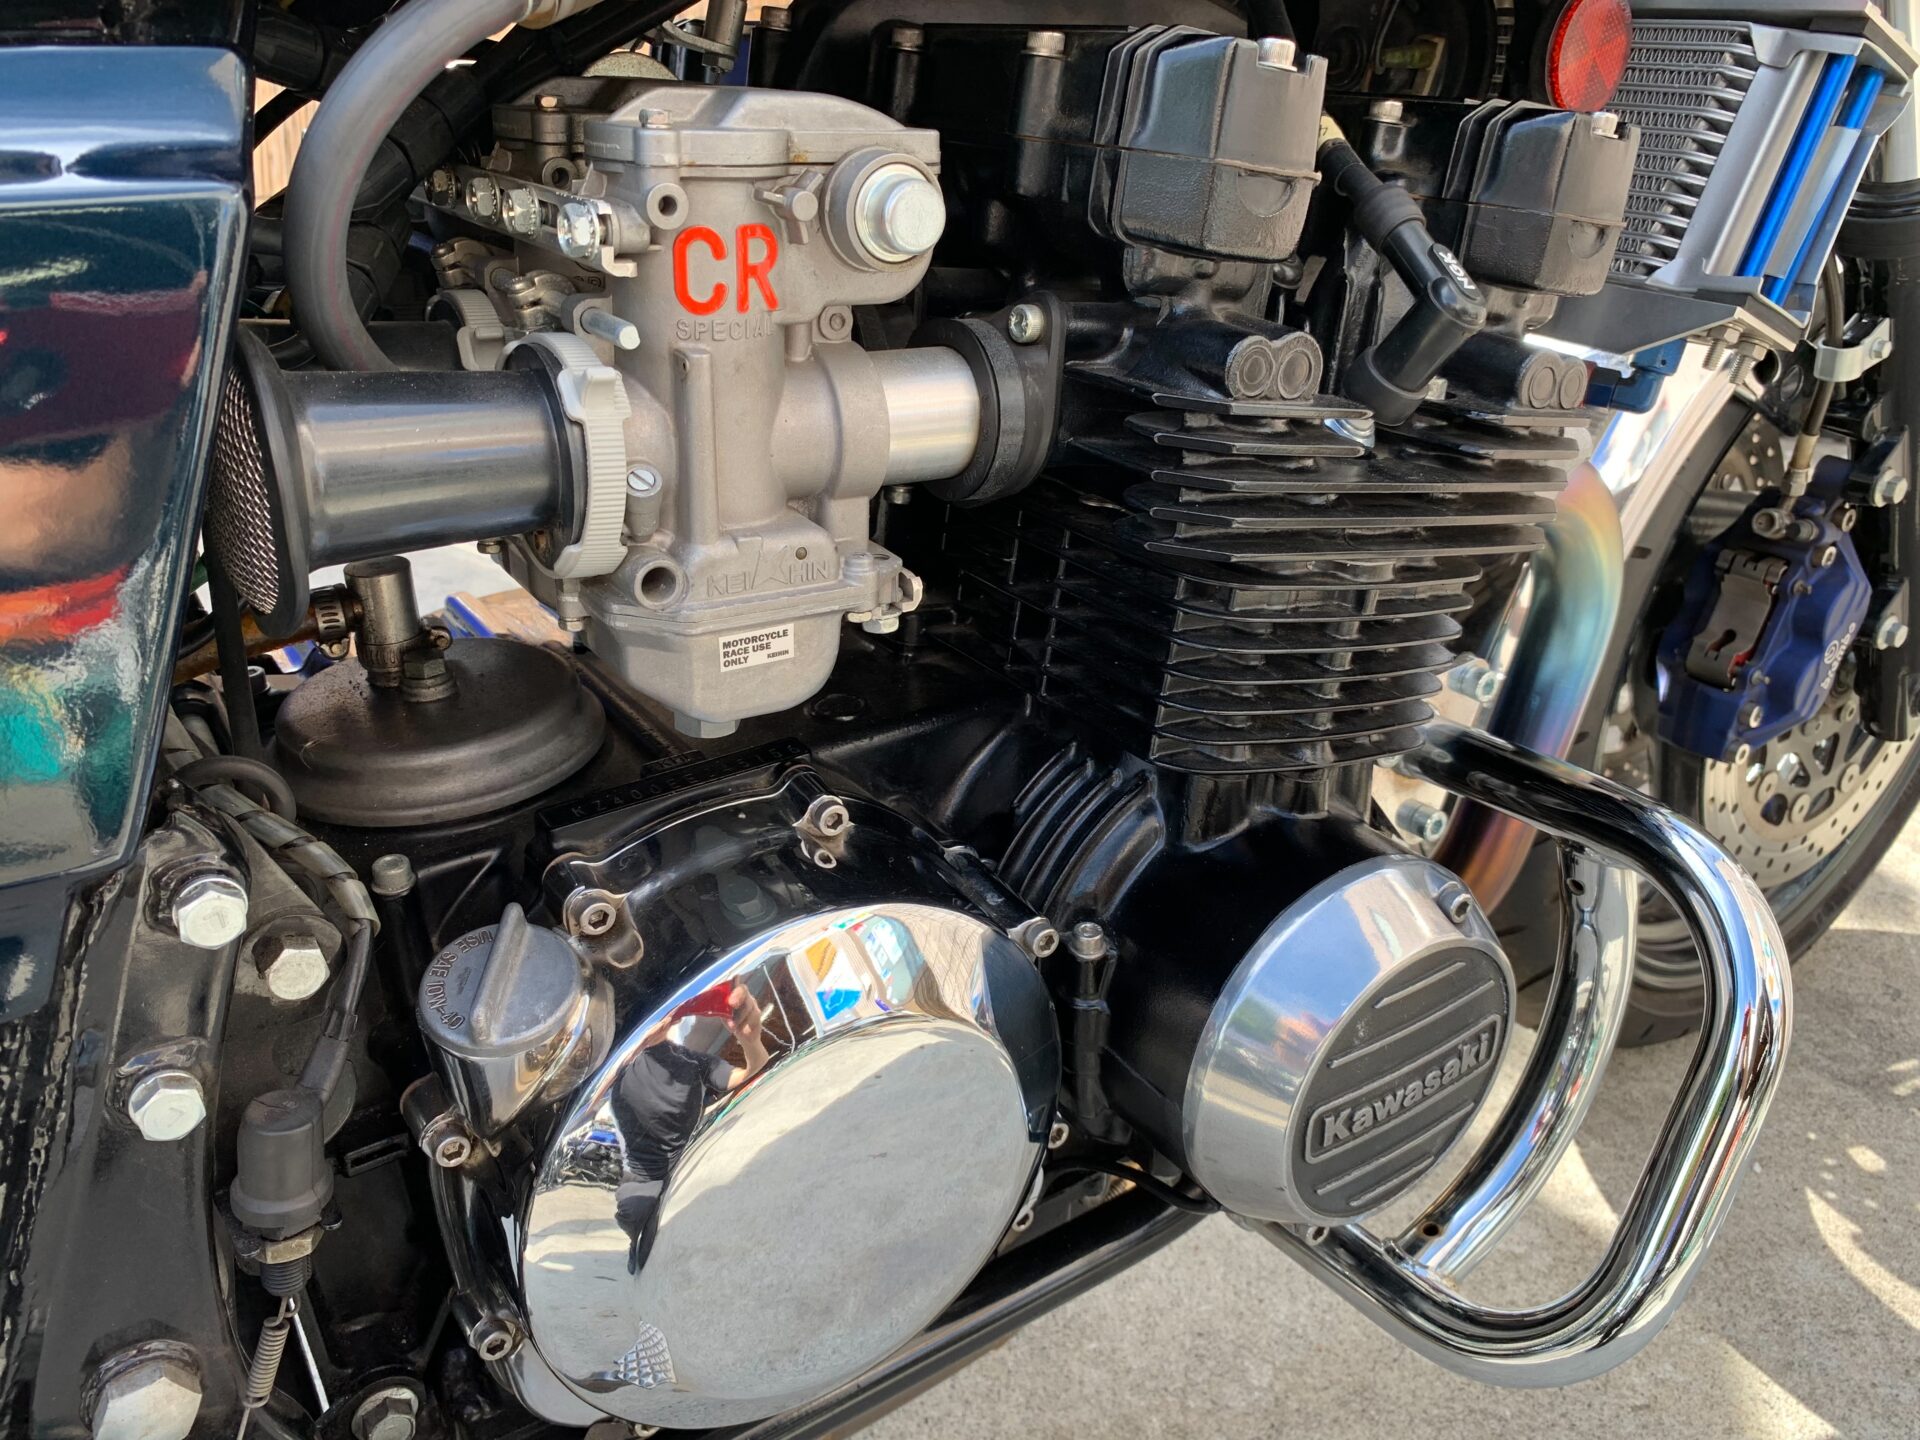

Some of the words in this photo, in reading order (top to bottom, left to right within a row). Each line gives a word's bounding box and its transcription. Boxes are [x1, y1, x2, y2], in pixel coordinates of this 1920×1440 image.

[672, 223, 779, 316] CR
[1438, 251, 1476, 290] NGK
[675, 312, 775, 342] SPECIAL
[722, 629, 789, 650] MOTORCYCLE
[723, 646, 750, 659] RACE
[752, 642, 772, 653] USE
[723, 655, 749, 668] ONLY
[767, 649, 790, 659] KEIHIN
[1820, 621, 1856, 690] brembo
[454, 929, 494, 954] USE
[427, 951, 458, 978] SAE
[426, 981, 466, 1031] 10W-40
[1321, 1032, 1490, 1148] Kawasaki
